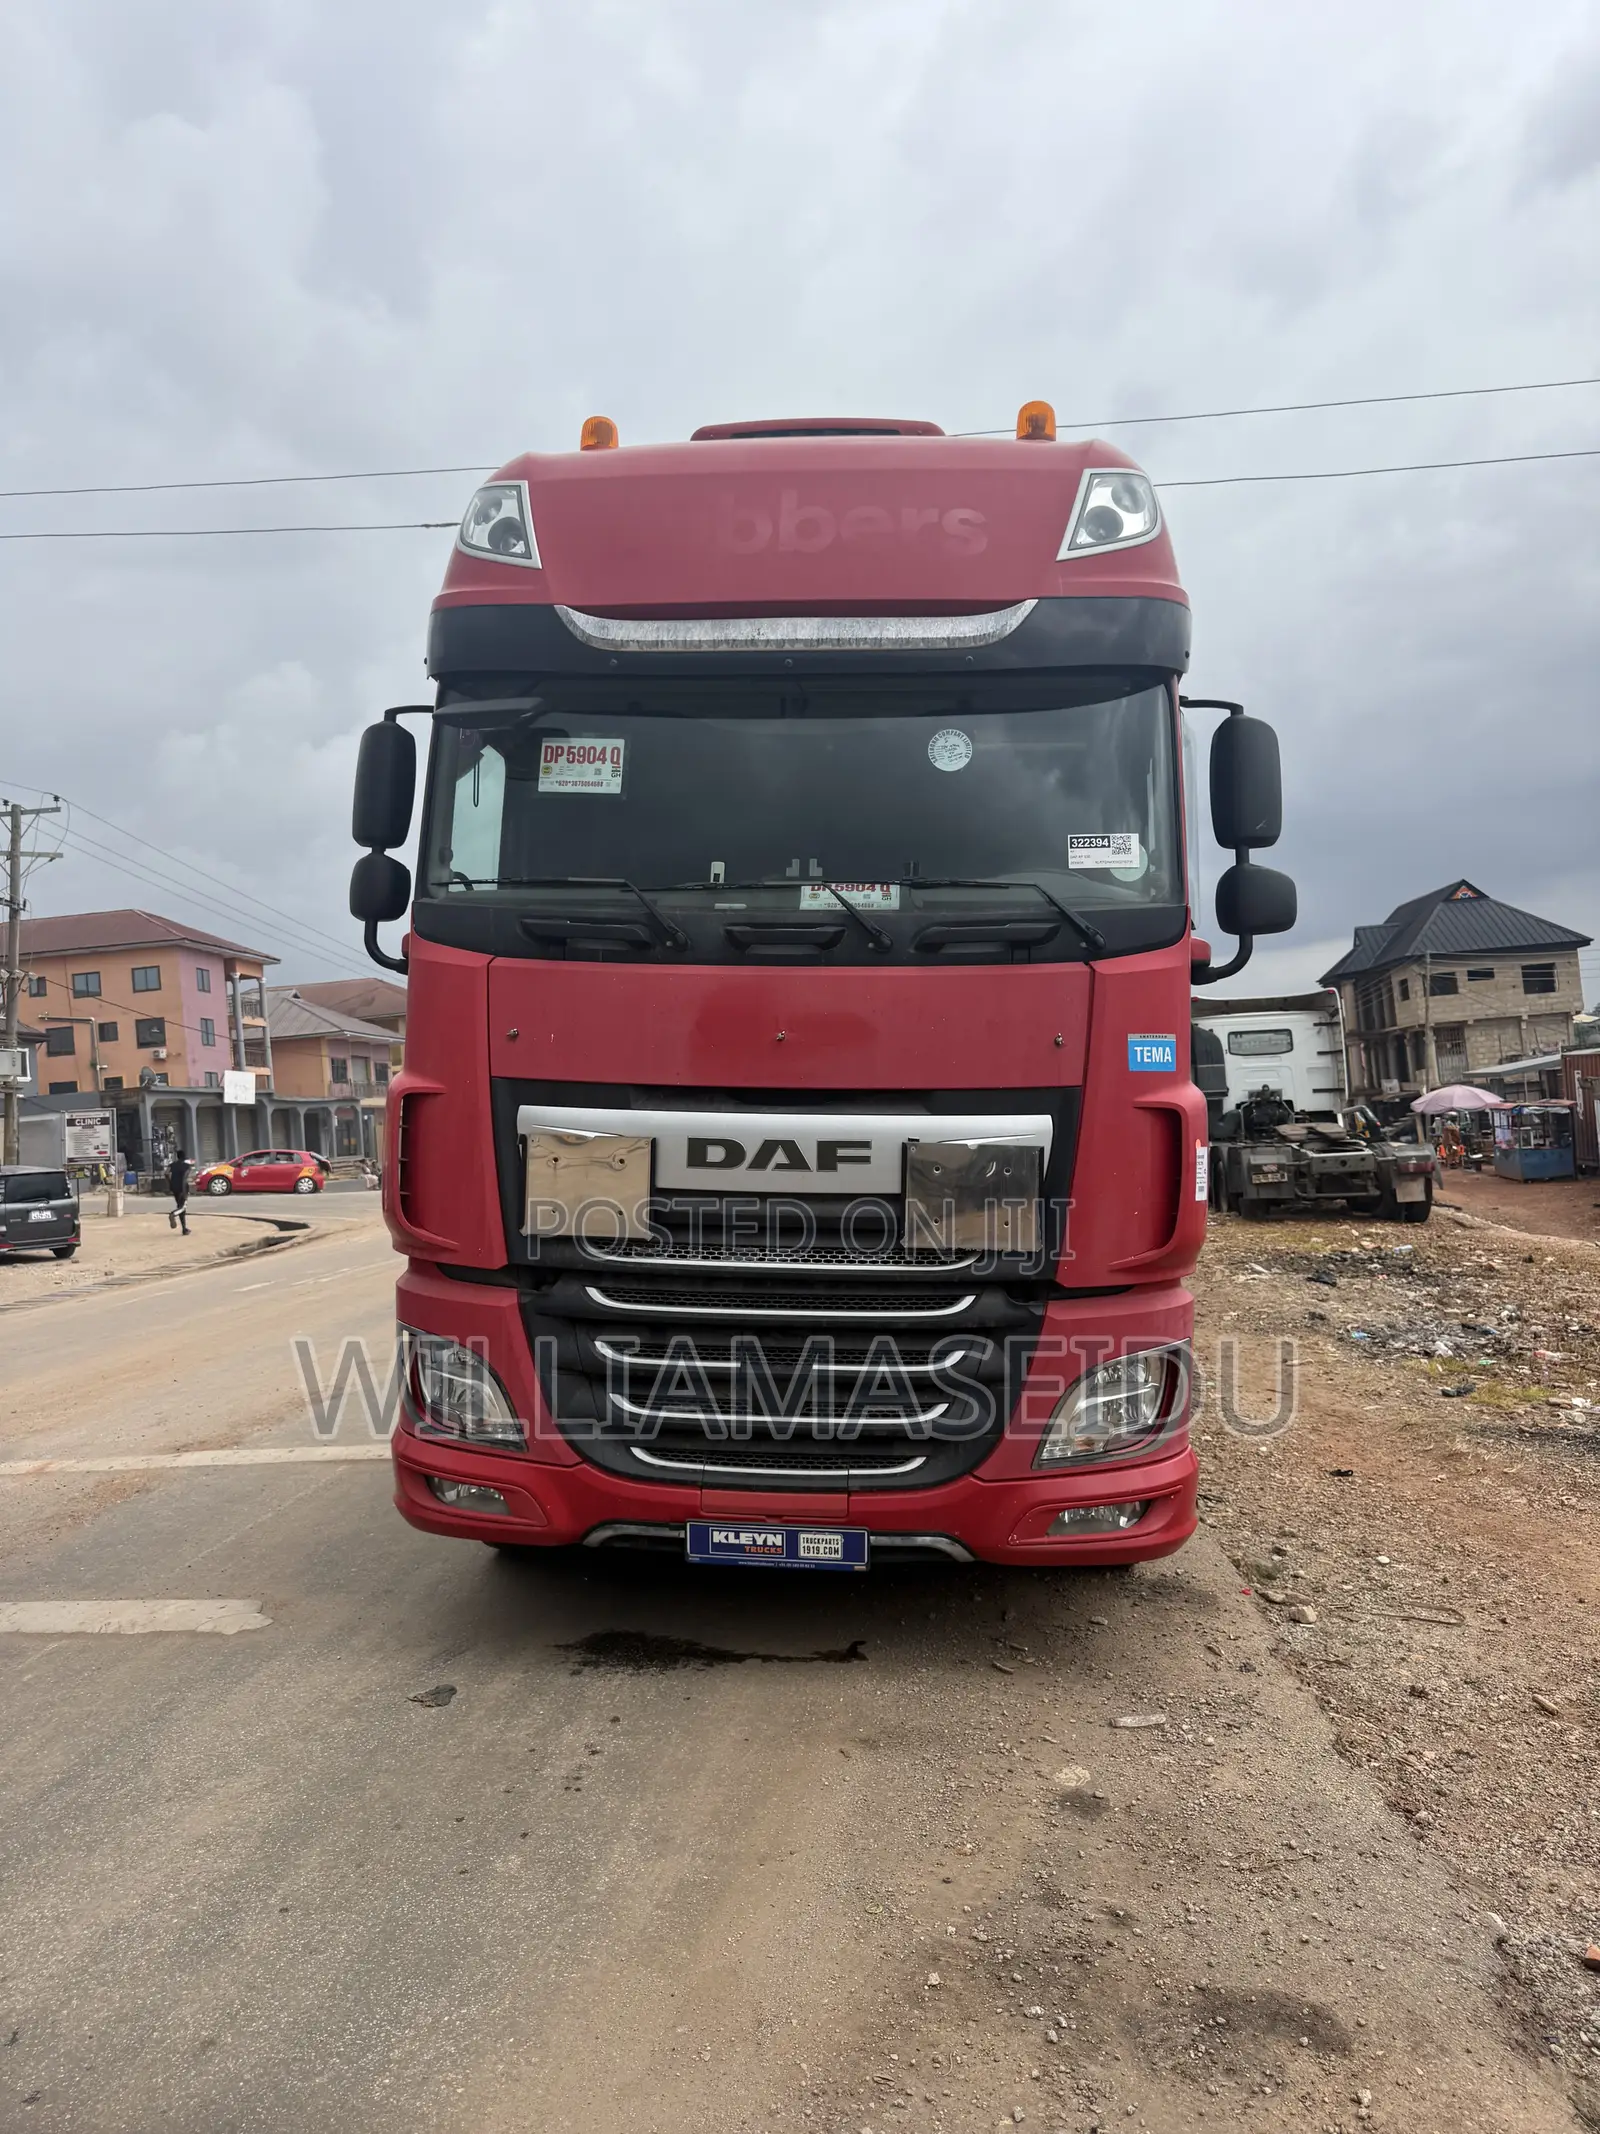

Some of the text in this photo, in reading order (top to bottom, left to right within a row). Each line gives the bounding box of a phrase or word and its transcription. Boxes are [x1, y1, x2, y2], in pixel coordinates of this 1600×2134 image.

[566, 745, 607, 765] 5904
[1071, 838, 1108, 848] 322394
[1133, 1046, 1172, 1063] TEMA
[75, 1117, 102, 1126] CLINIC
[686, 1136, 873, 1172] DAF
[712, 1530, 782, 1546] KLEYN
[802, 1536, 840, 1546] TRUCKPARTS
[744, 1545, 782, 1554] TRUCKS
[802, 1545, 840, 1556] 1919.COM
